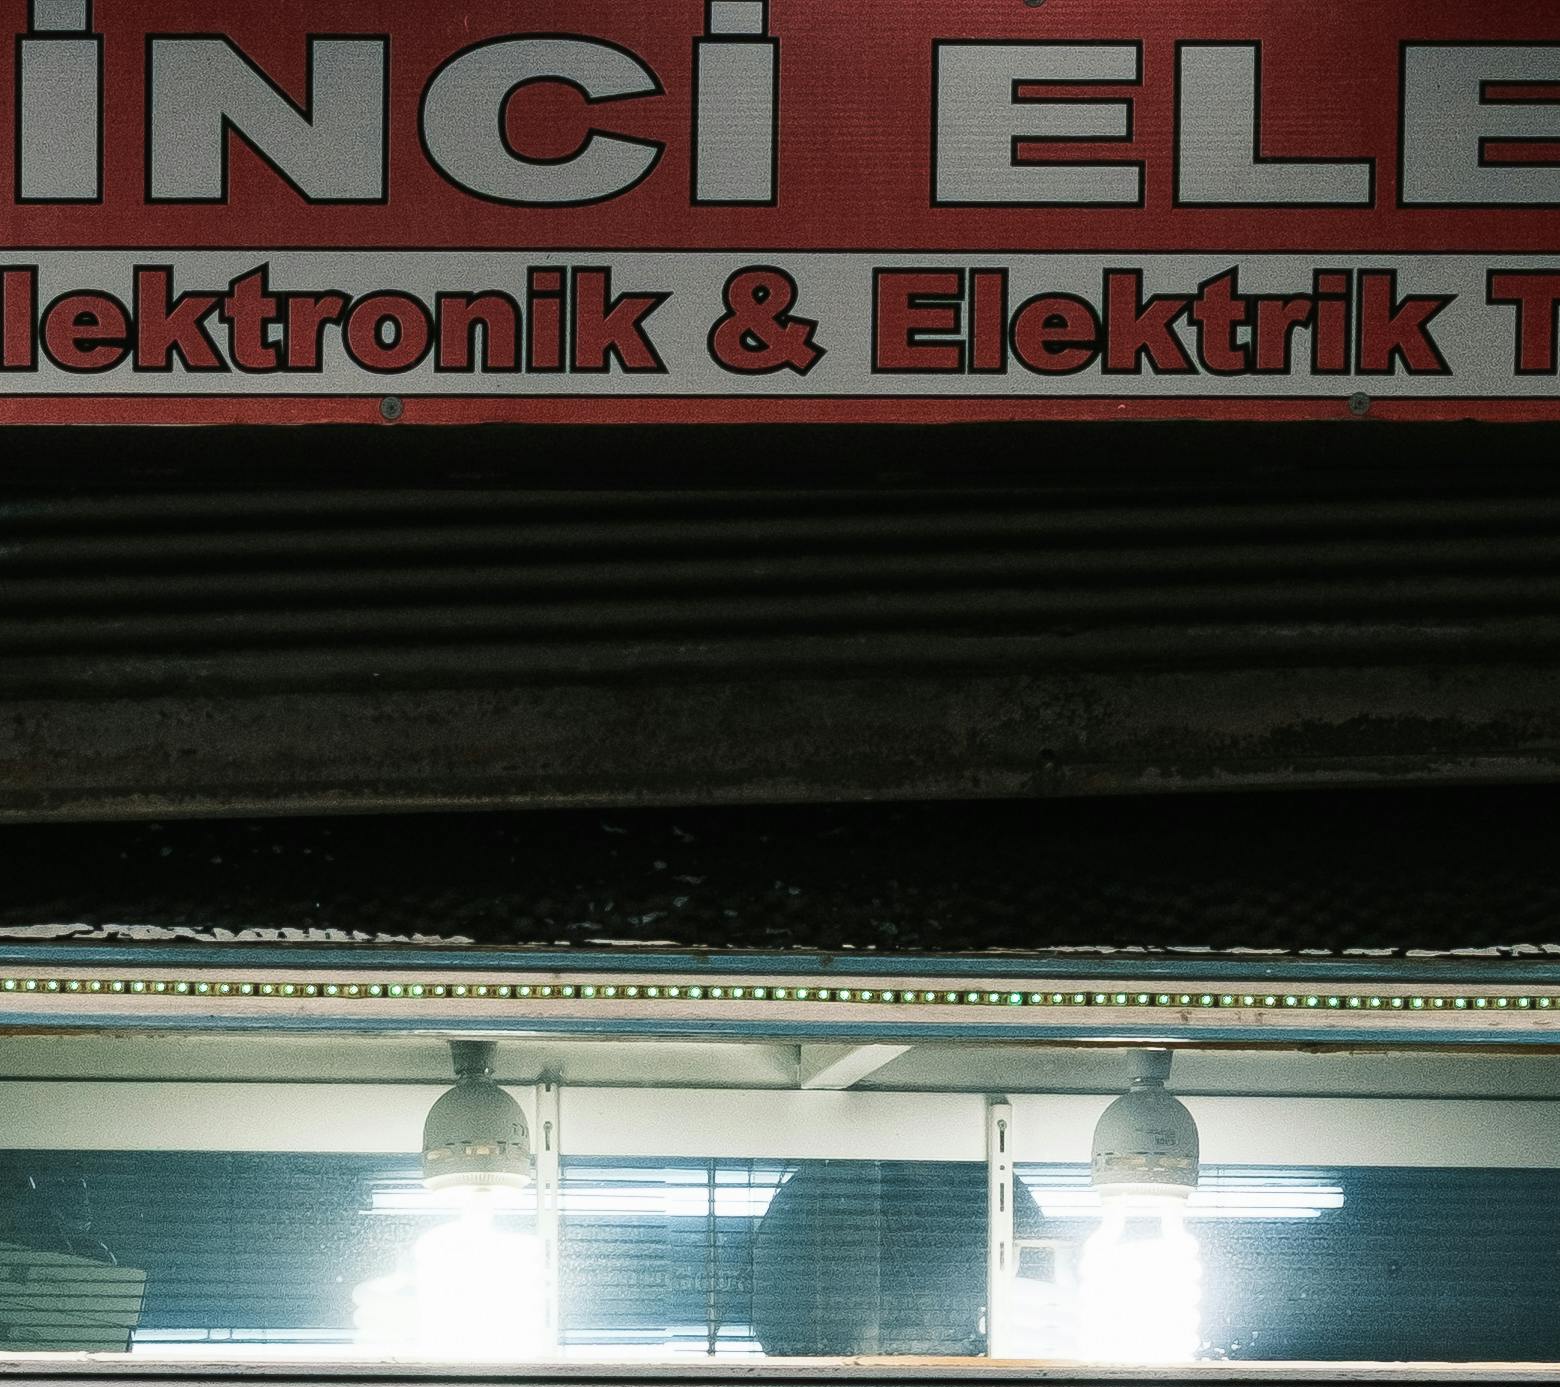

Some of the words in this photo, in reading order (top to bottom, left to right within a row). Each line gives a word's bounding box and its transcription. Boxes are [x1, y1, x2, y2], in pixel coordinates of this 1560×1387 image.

[11, 0, 782, 209] İNCİ
[706, 264, 827, 380] &
[868, 260, 1458, 380] Elektrik
